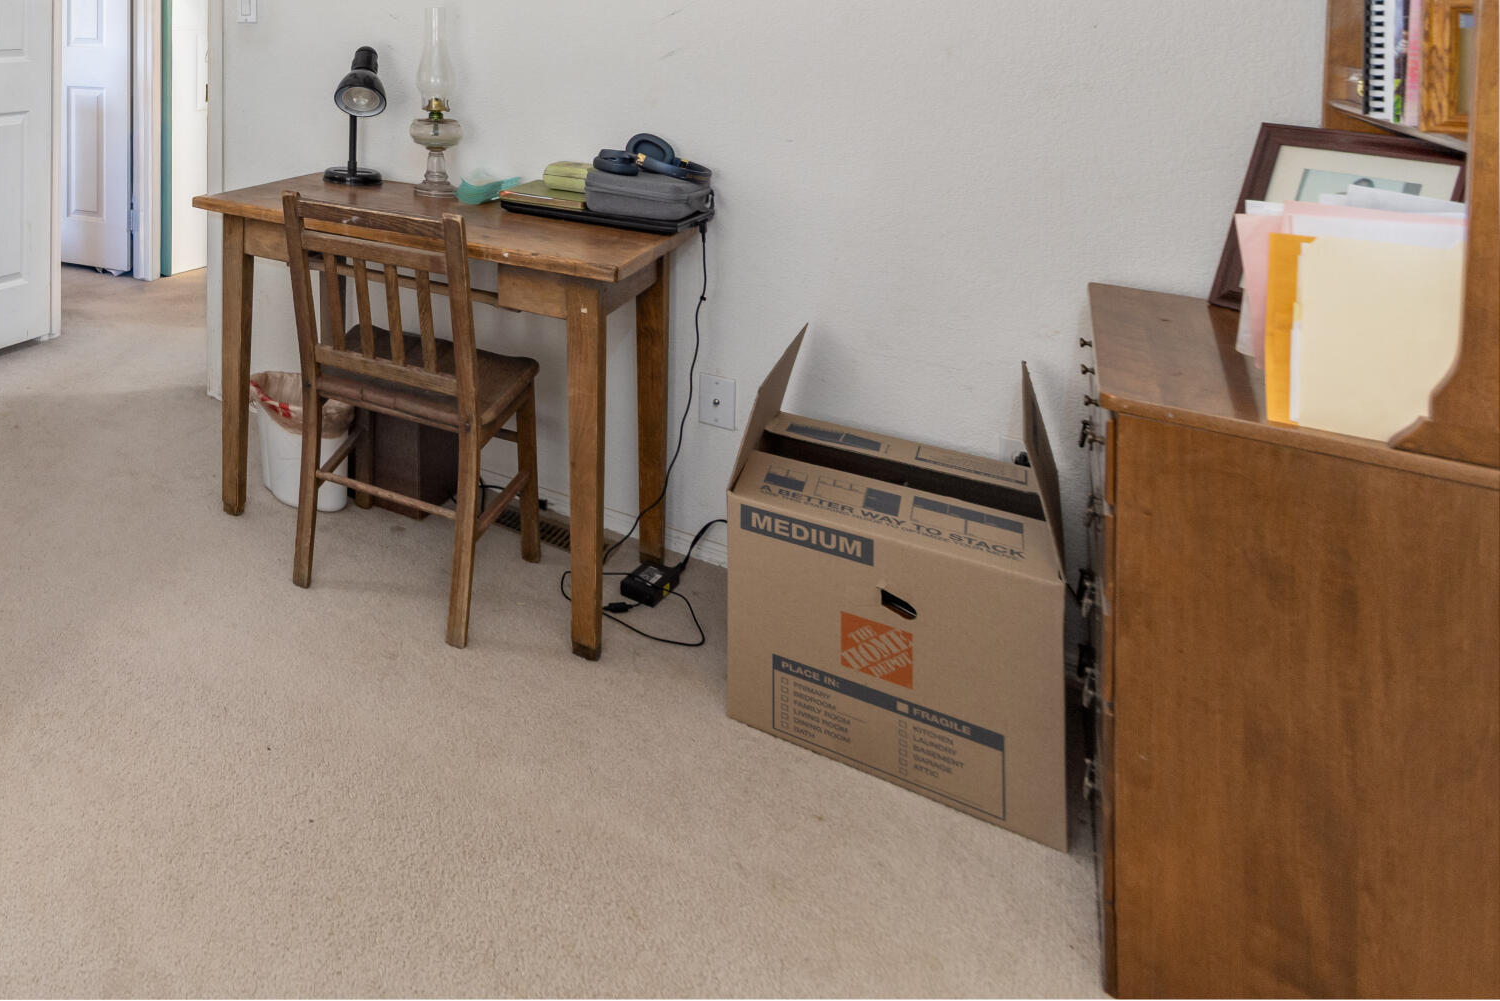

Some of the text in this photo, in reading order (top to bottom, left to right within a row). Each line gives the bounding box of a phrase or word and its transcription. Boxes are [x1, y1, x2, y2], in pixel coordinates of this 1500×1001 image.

[750, 511, 863, 558] MEDIUM
[778, 488, 854, 513] BETTER
[861, 509, 906, 527] WAY
[912, 522, 942, 536] TO
[949, 532, 1026, 560] STACK
[848, 624, 877, 644] THE
[841, 629, 914, 670] HOME
[781, 660, 840, 689] PLACE IN:
[868, 651, 912, 678] DEPOT
[822, 719, 849, 734] ROOM
[824, 710, 851, 725] ROOM
[913, 707, 973, 736] FRAGILE
[824, 728, 852, 744] ROOM
